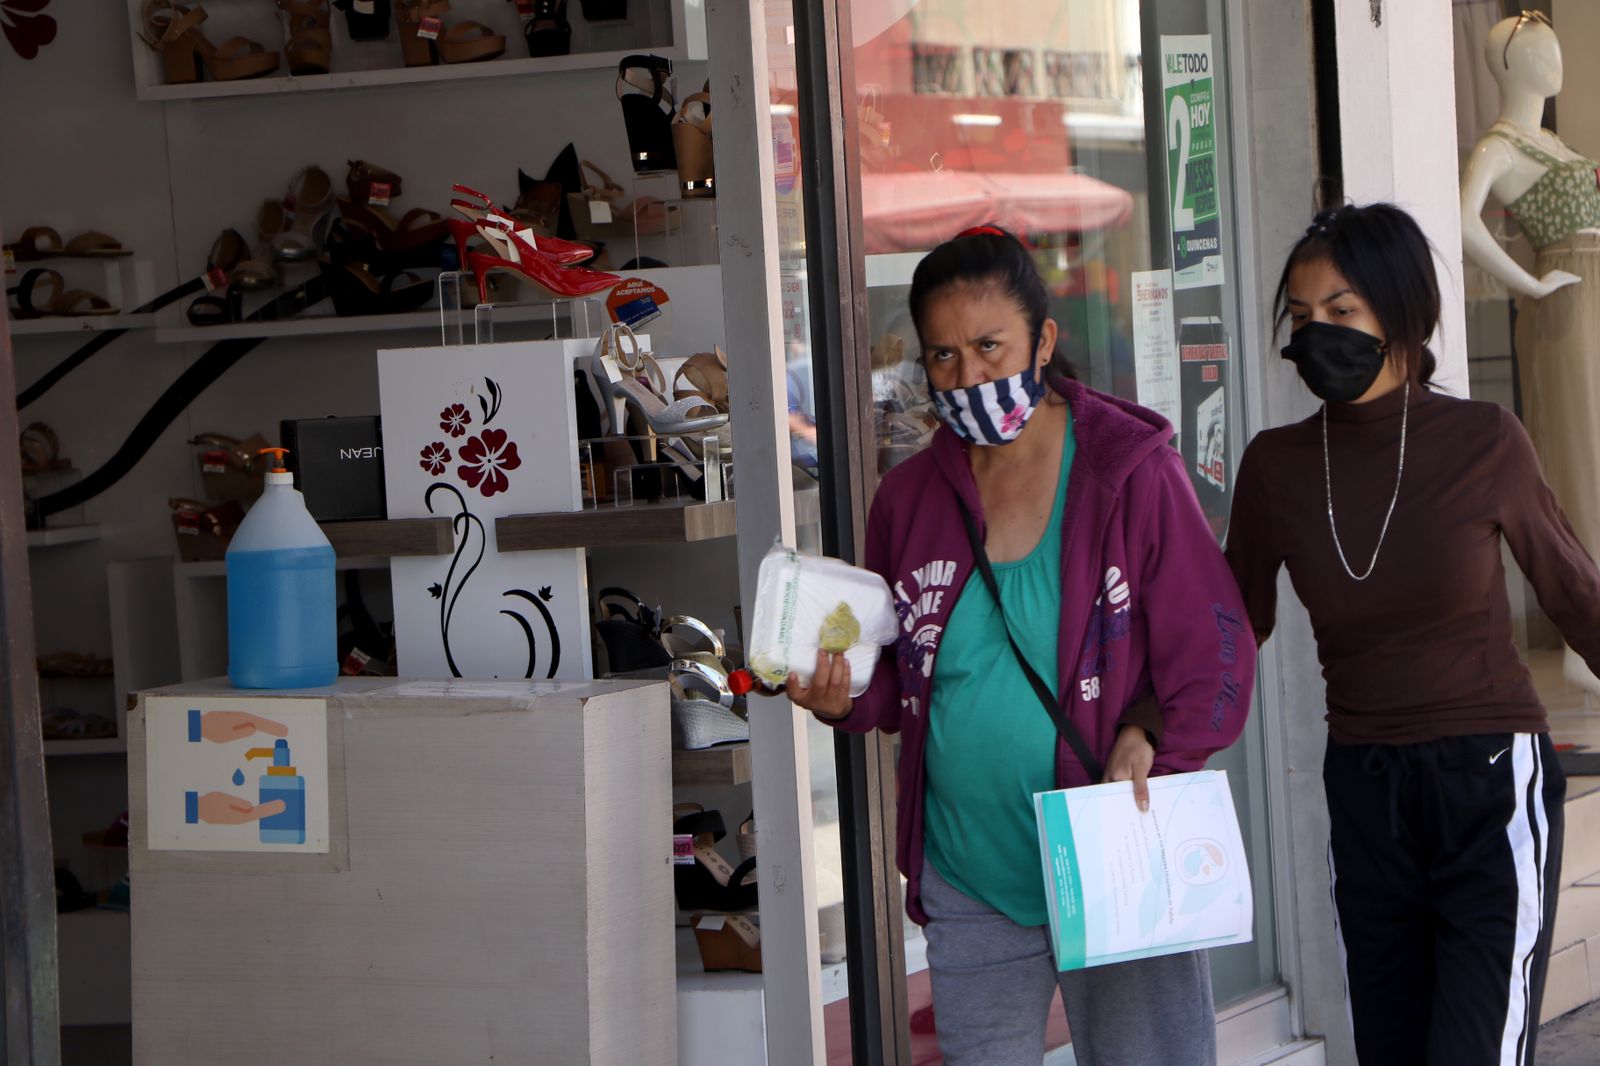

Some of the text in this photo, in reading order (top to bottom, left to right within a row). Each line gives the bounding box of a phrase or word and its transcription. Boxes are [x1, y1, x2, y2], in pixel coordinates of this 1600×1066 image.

[1191, 102, 1211, 128] HOY
[1169, 95, 1195, 231] 2
[1187, 237, 1218, 252] QUINCENAS
[616, 287, 656, 296] ACEPTAMOS
[340, 446, 381, 459] JEAN
[912, 560, 957, 592] YOUR
